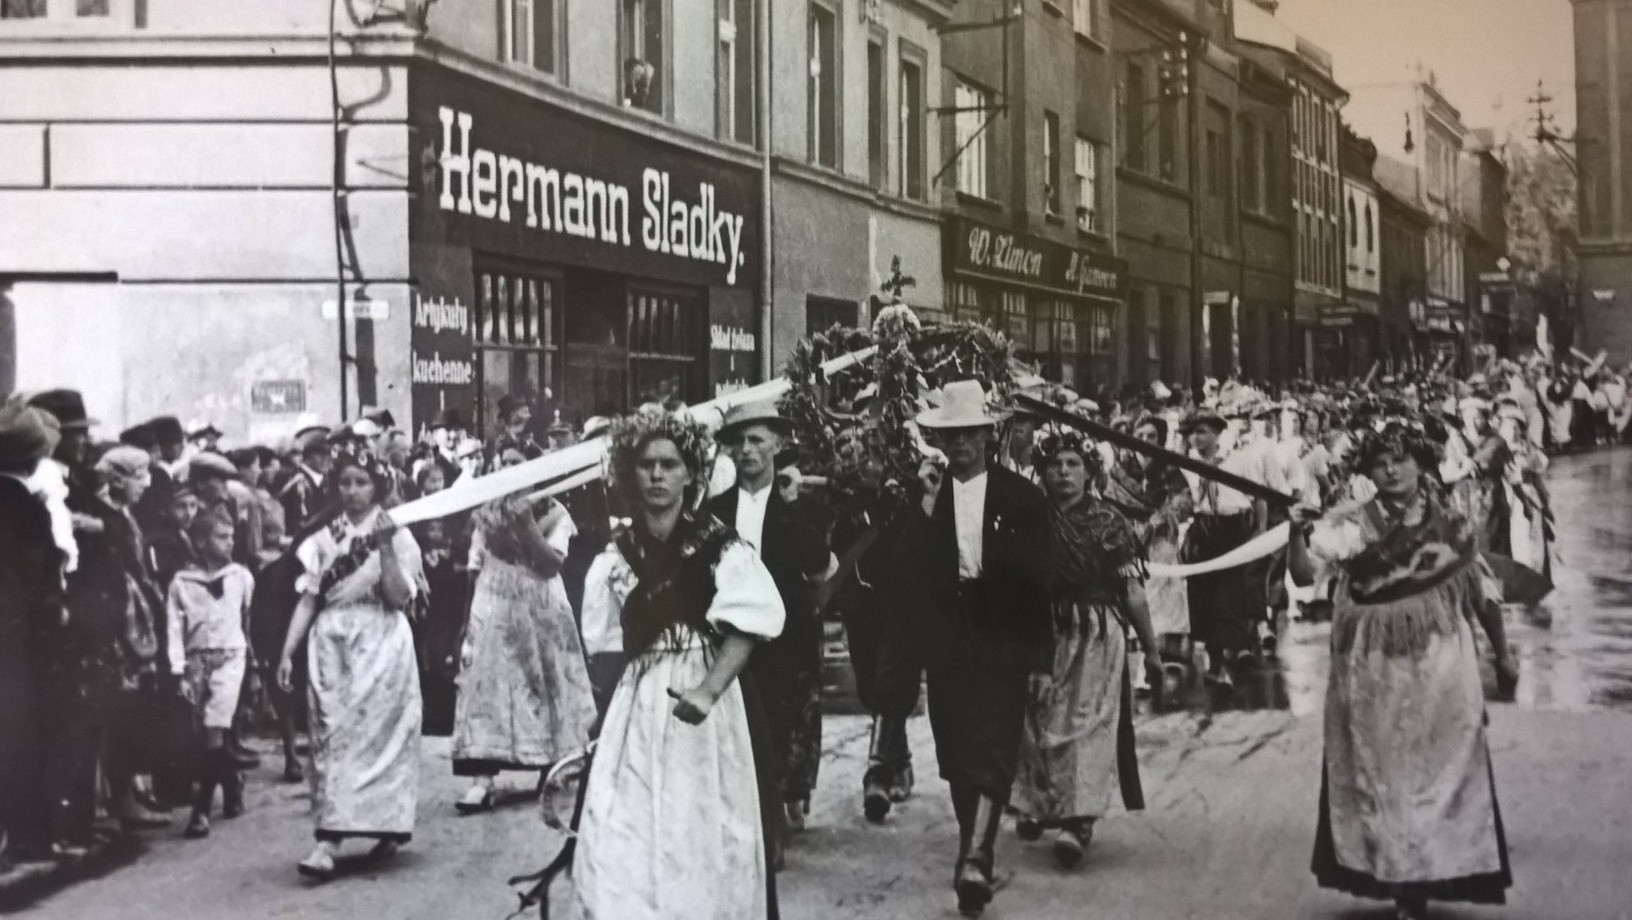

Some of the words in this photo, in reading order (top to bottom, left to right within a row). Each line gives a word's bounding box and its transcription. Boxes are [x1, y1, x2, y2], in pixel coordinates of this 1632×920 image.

[439, 105, 631, 246] Hermann
[642, 167, 746, 285] Sladky.
[413, 351, 472, 384] kuchenne
